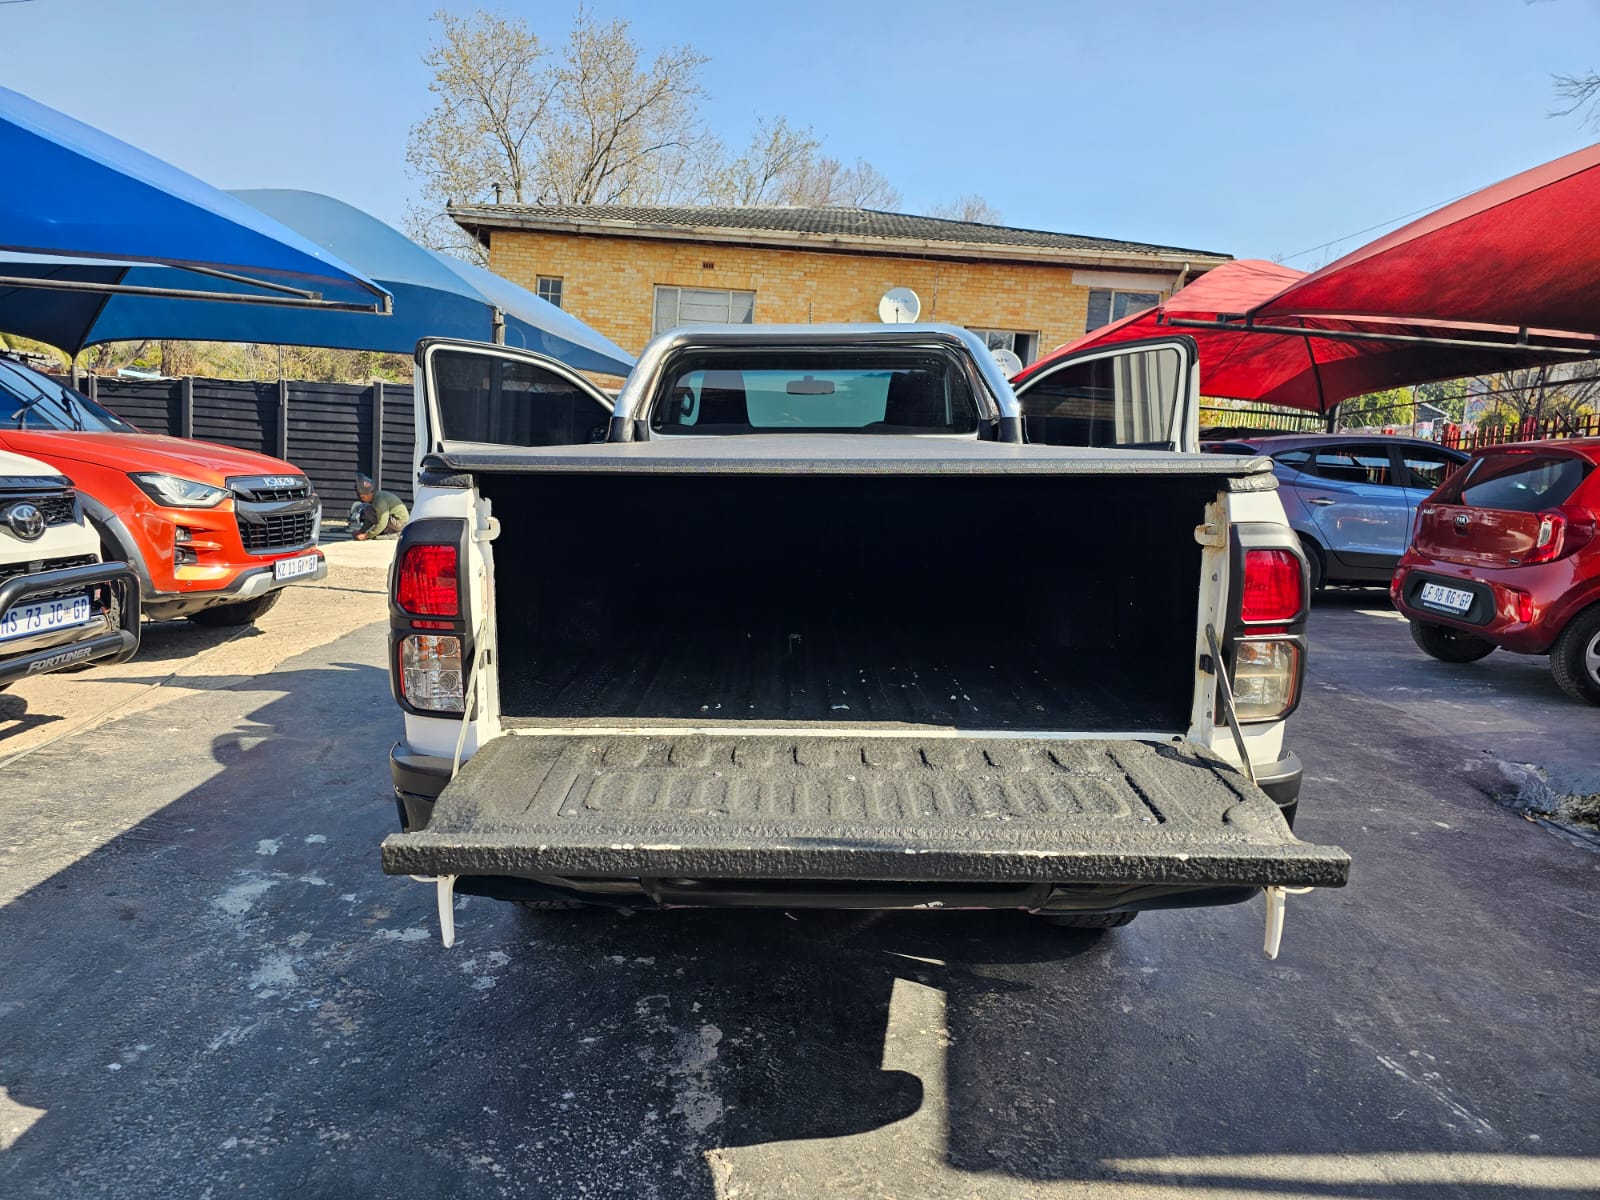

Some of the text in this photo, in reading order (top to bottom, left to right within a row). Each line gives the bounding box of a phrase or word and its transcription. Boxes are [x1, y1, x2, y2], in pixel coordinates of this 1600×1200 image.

[264, 477, 296, 487] ISUZU
[1445, 590, 1457, 604] RG
[1459, 593, 1471, 607] GP
[26, 607, 41, 629] 73
[48, 603, 63, 625] JC
[73, 599, 87, 620] GP
[26, 647, 92, 674] FORTUNER
